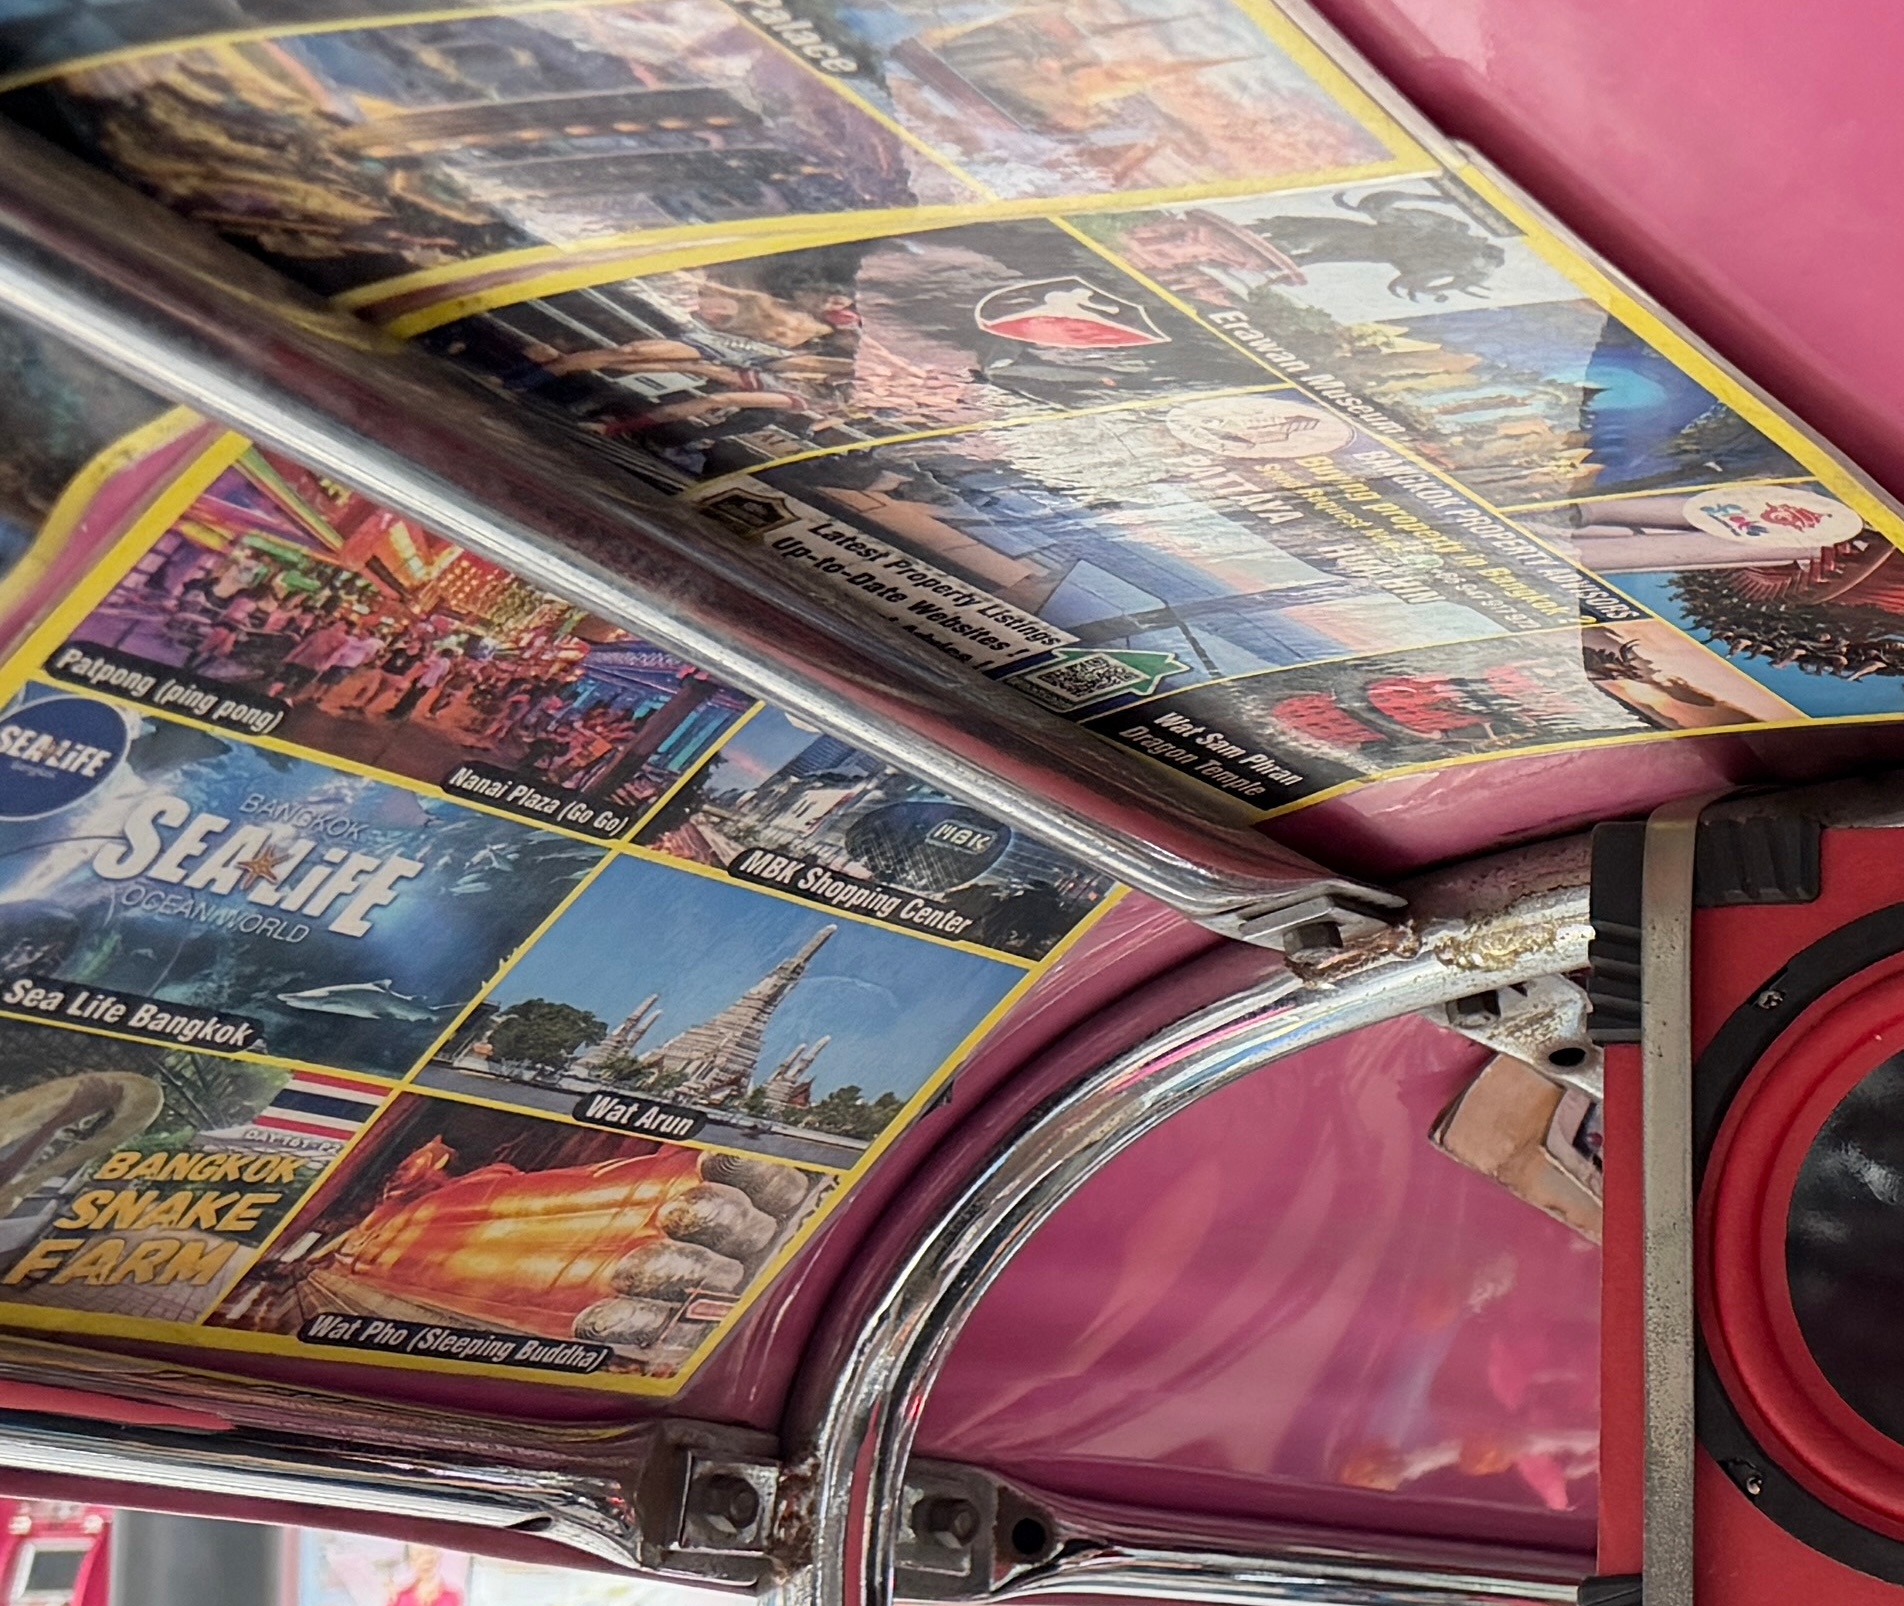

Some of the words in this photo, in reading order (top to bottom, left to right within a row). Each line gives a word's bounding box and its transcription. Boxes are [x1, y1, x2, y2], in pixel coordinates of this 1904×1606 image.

[735, 0, 857, 72] alace
[1208, 308, 1310, 374] Erawan
[1301, 372, 1407, 441] Museum
[1295, 455, 1382, 501] Buying
[1361, 503, 1467, 553] property
[1478, 567, 1571, 616] Bangkok
[1352, 450, 1467, 508] BANGKOK
[1446, 508, 1560, 567] PROPERTY
[1538, 567, 1640, 619] ADVISORS
[771, 536, 908, 603] Up-to-Date
[908, 598, 1008, 652] Websites
[809, 522, 890, 565] Latest
[884, 557, 979, 607] Property
[976, 597, 1062, 647] Listings
[56, 647, 156, 698] Patpong
[154, 677, 217, 718] (ping
[215, 700, 284, 735] pong)
[1119, 725, 1199, 763] Dragon
[1195, 758, 1267, 797] Temple
[1153, 711, 1203, 738] Wat
[1196, 727, 1247, 759] Sam
[1248, 753, 1303, 787] Phran
[238, 793, 369, 839] BANGKOK
[449, 767, 509, 799] Nanai
[509, 784, 559, 814] Plaza
[559, 800, 594, 826] (Go
[594, 809, 630, 838] Go)
[933, 823, 991, 850] MBK
[93, 797, 272, 897] SEA
[739, 851, 800, 884] MBK
[798, 867, 901, 918] Shopping
[900, 898, 973, 935] Center
[5, 979, 64, 1011] Sea
[66, 992, 119, 1023] Life
[129, 1003, 254, 1046] Bangkok
[585, 1096, 636, 1126] Wat
[634, 1105, 693, 1136] Arun
[94, 1151, 303, 1183] BANGKOK
[53, 1192, 281, 1232] SNAKE
[2, 1239, 238, 1287] FARM
[305, 1315, 355, 1342] Wat
[365, 1320, 406, 1346] Pho
[406, 1326, 516, 1362] (Sleeping
[518, 1338, 606, 1373] Buddha)
